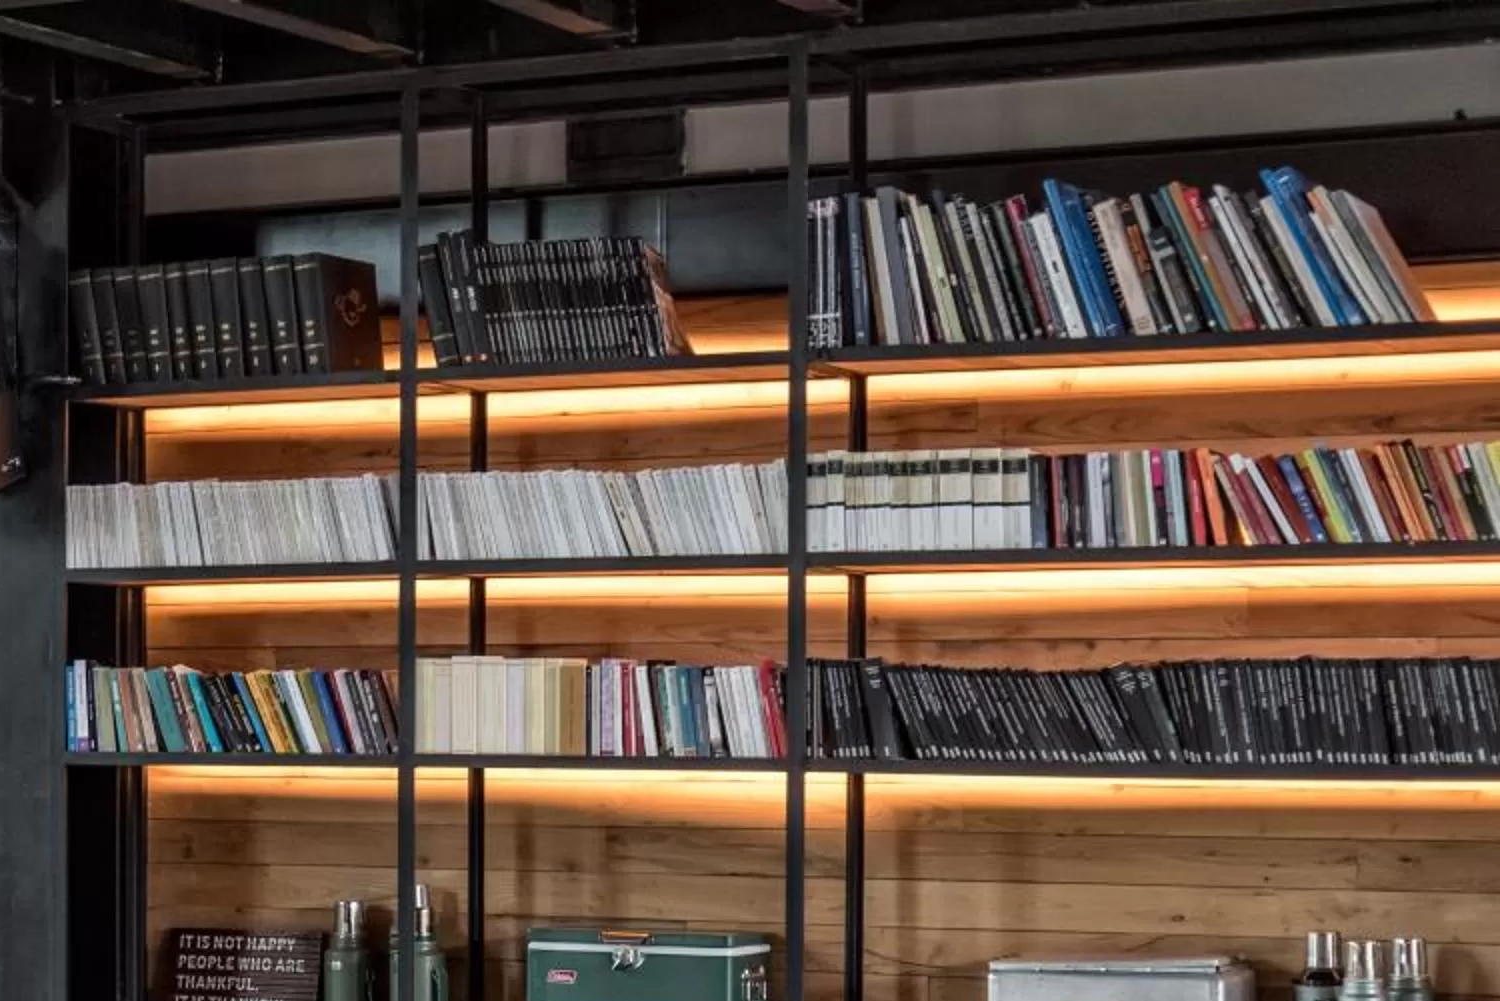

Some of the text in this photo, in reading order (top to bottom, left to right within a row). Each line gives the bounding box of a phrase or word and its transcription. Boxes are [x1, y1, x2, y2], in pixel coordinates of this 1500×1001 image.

[179, 934, 296, 952] IT IS NOT HAPPY
[178, 954, 305, 973] PEOPLE WHO ARE
